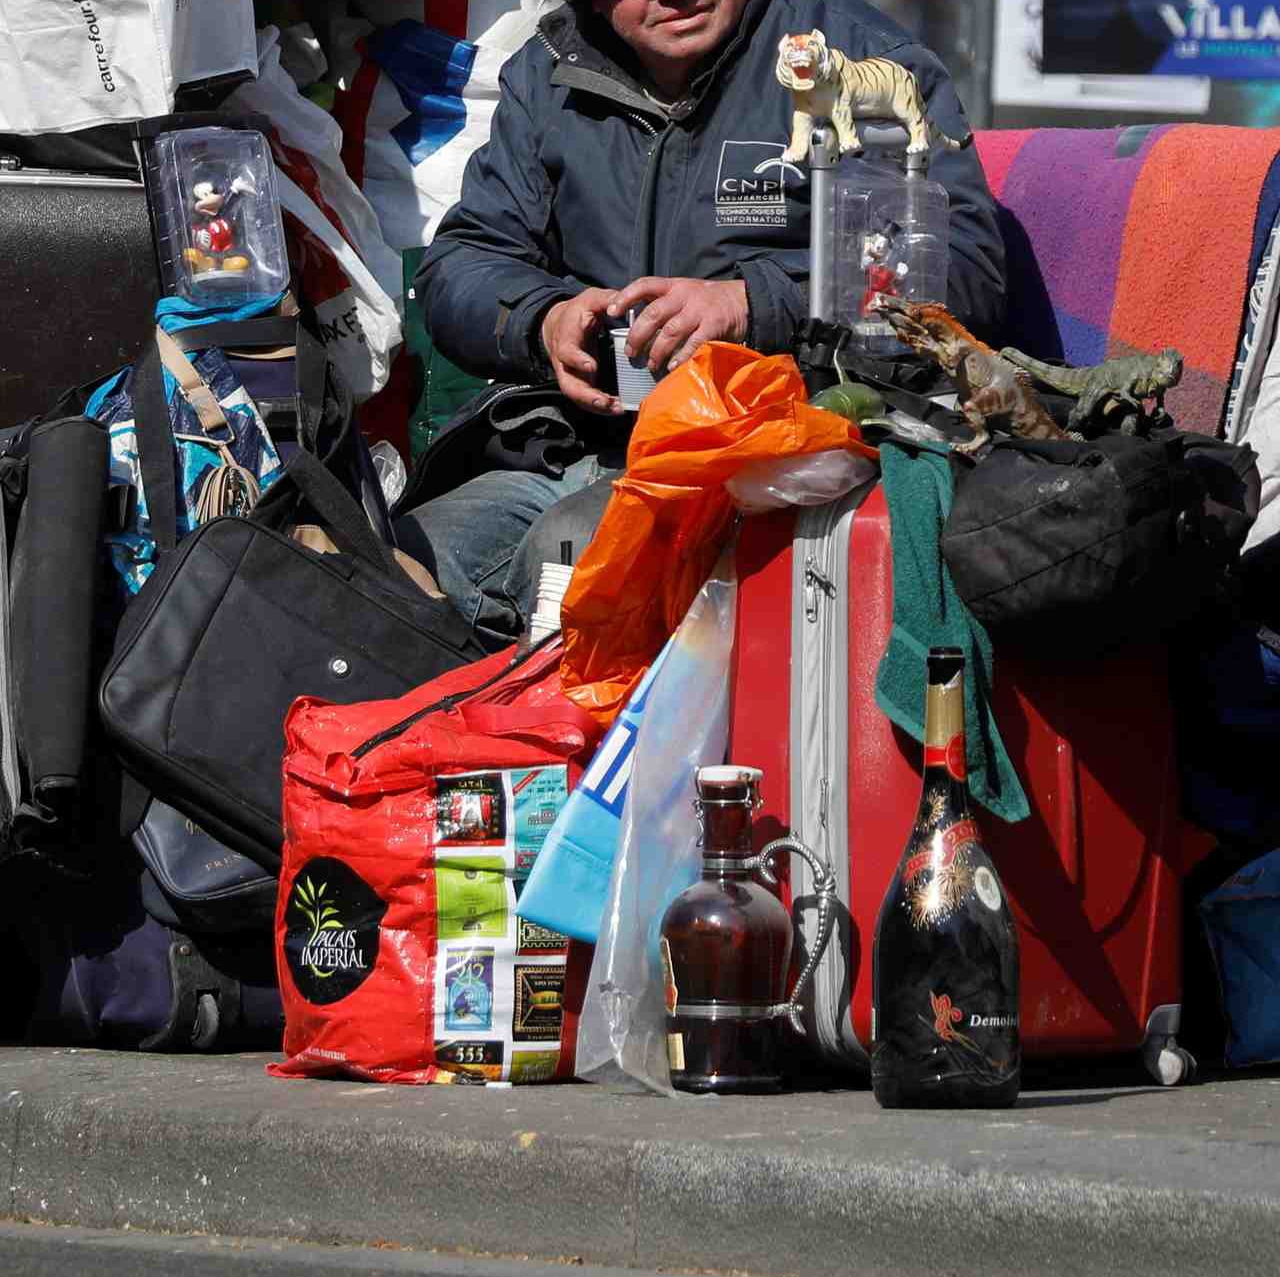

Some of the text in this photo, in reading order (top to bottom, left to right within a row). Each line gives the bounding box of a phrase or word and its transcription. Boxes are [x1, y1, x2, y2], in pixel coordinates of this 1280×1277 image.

[721, 178, 779, 194] CNP
[312, 929, 357, 949] PALAIS
[301, 946, 368, 970] IMPERIAL
